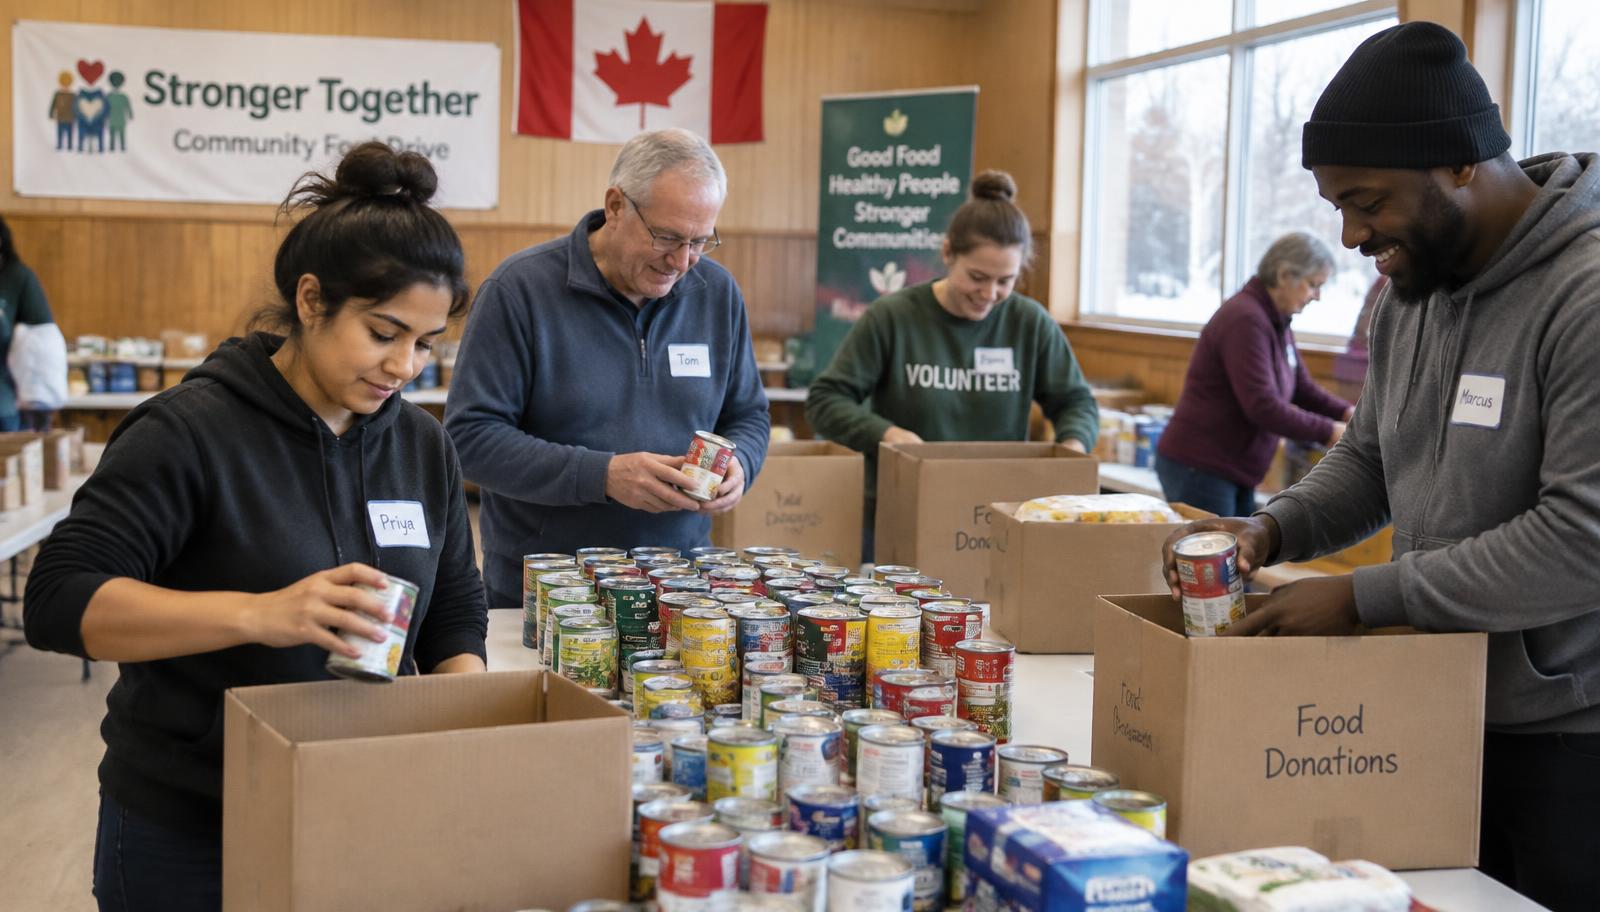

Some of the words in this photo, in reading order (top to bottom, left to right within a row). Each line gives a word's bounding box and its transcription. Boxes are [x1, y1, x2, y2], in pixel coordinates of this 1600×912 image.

[144, 70, 310, 119] Stronger
[319, 78, 480, 123] Together
[174, 129, 316, 160] Community
[324, 134, 378, 156] Fo
[847, 146, 893, 167] Good
[897, 145, 941, 167] Food
[829, 175, 896, 199] Healthy
[899, 172, 960, 198] People
[854, 202, 931, 227] Stronger
[676, 353, 700, 366] Tom
[905, 363, 1021, 392] VOLUNTEER
[1459, 388, 1494, 409] Marcus
[380, 513, 416, 536] Priya
[973, 504, 993, 525] Fo
[1296, 704, 1364, 737] Food
[1265, 746, 1399, 779] Donations
